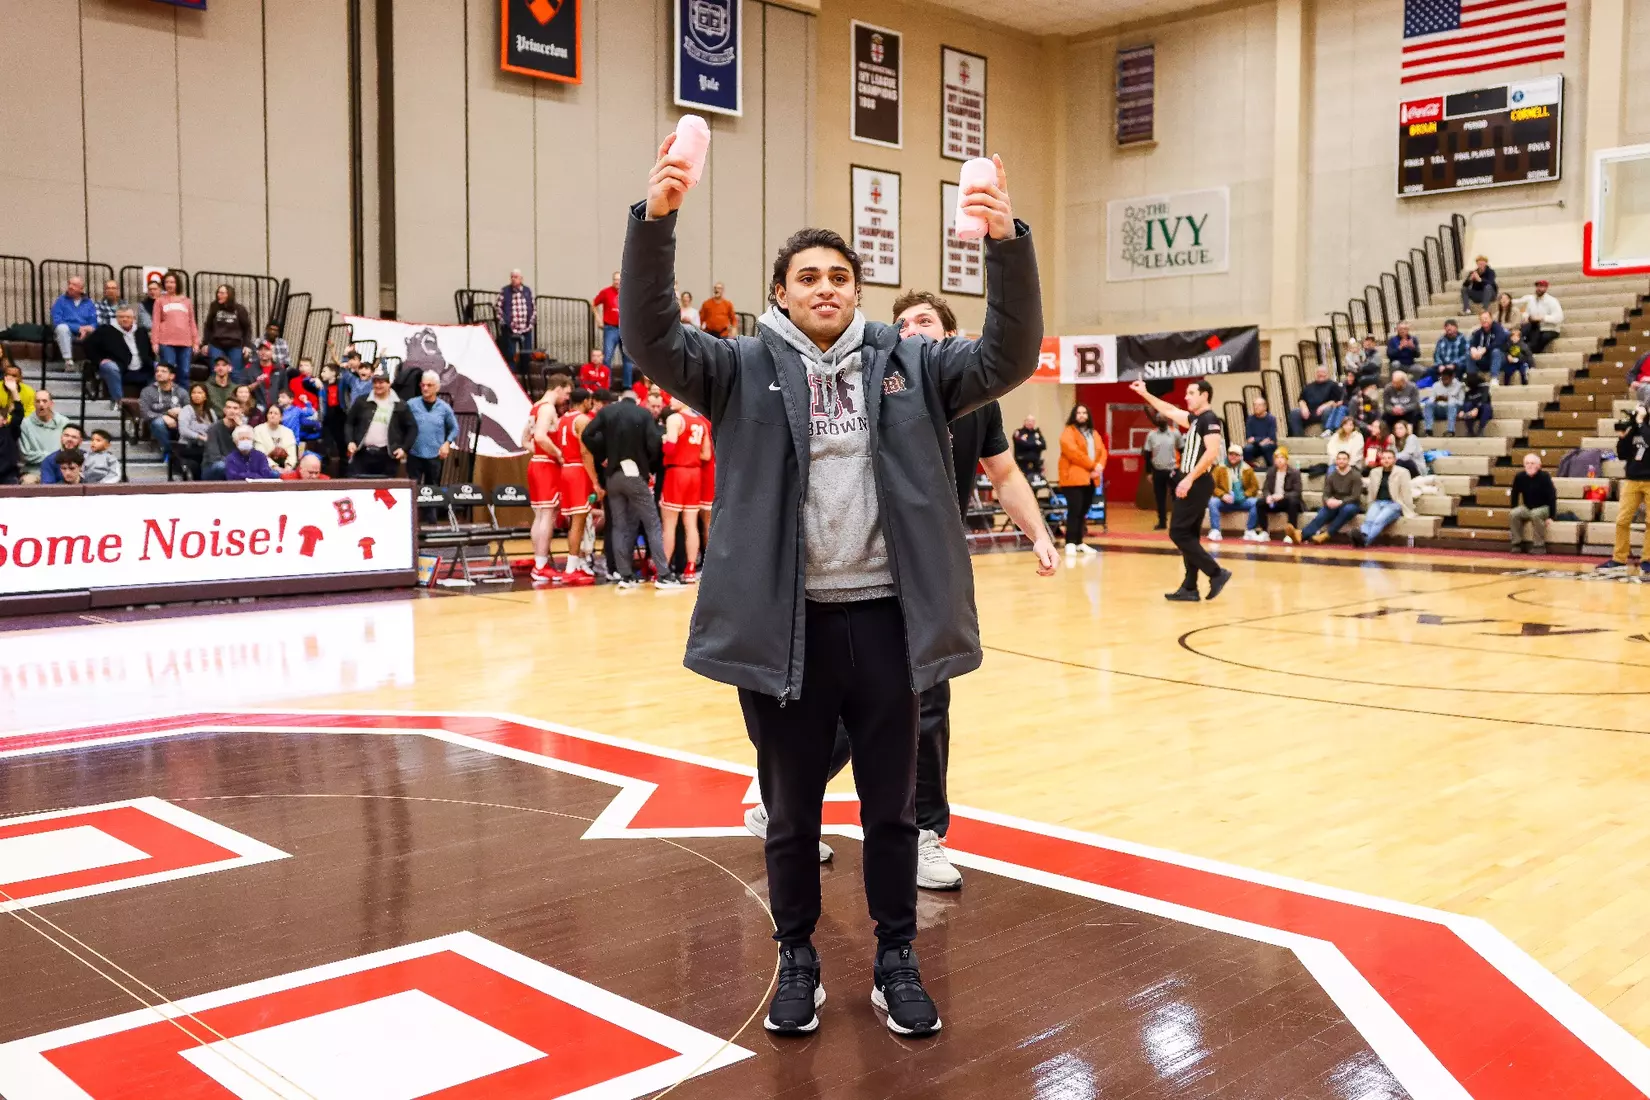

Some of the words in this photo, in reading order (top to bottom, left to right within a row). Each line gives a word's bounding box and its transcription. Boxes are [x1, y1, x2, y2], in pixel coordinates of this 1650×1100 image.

[516, 34, 568, 59] Princeton
[699, 74, 719, 91] Yale
[858, 82, 897, 101] CHAMPIONS
[1408, 103, 1440, 119] Coca-Cola
[1510, 106, 1550, 121] CORNELL
[1409, 121, 1437, 136] BROWN
[1145, 203, 1169, 215] THE
[1144, 213, 1208, 251] IVY
[1145, 250, 1212, 269] LEAGUE
[1074, 343, 1104, 379] B
[1144, 354, 1231, 379] SHAWMUT
[808, 417, 869, 436] BROWN
[333, 497, 357, 527] B
[139, 514, 287, 561] Noise!
